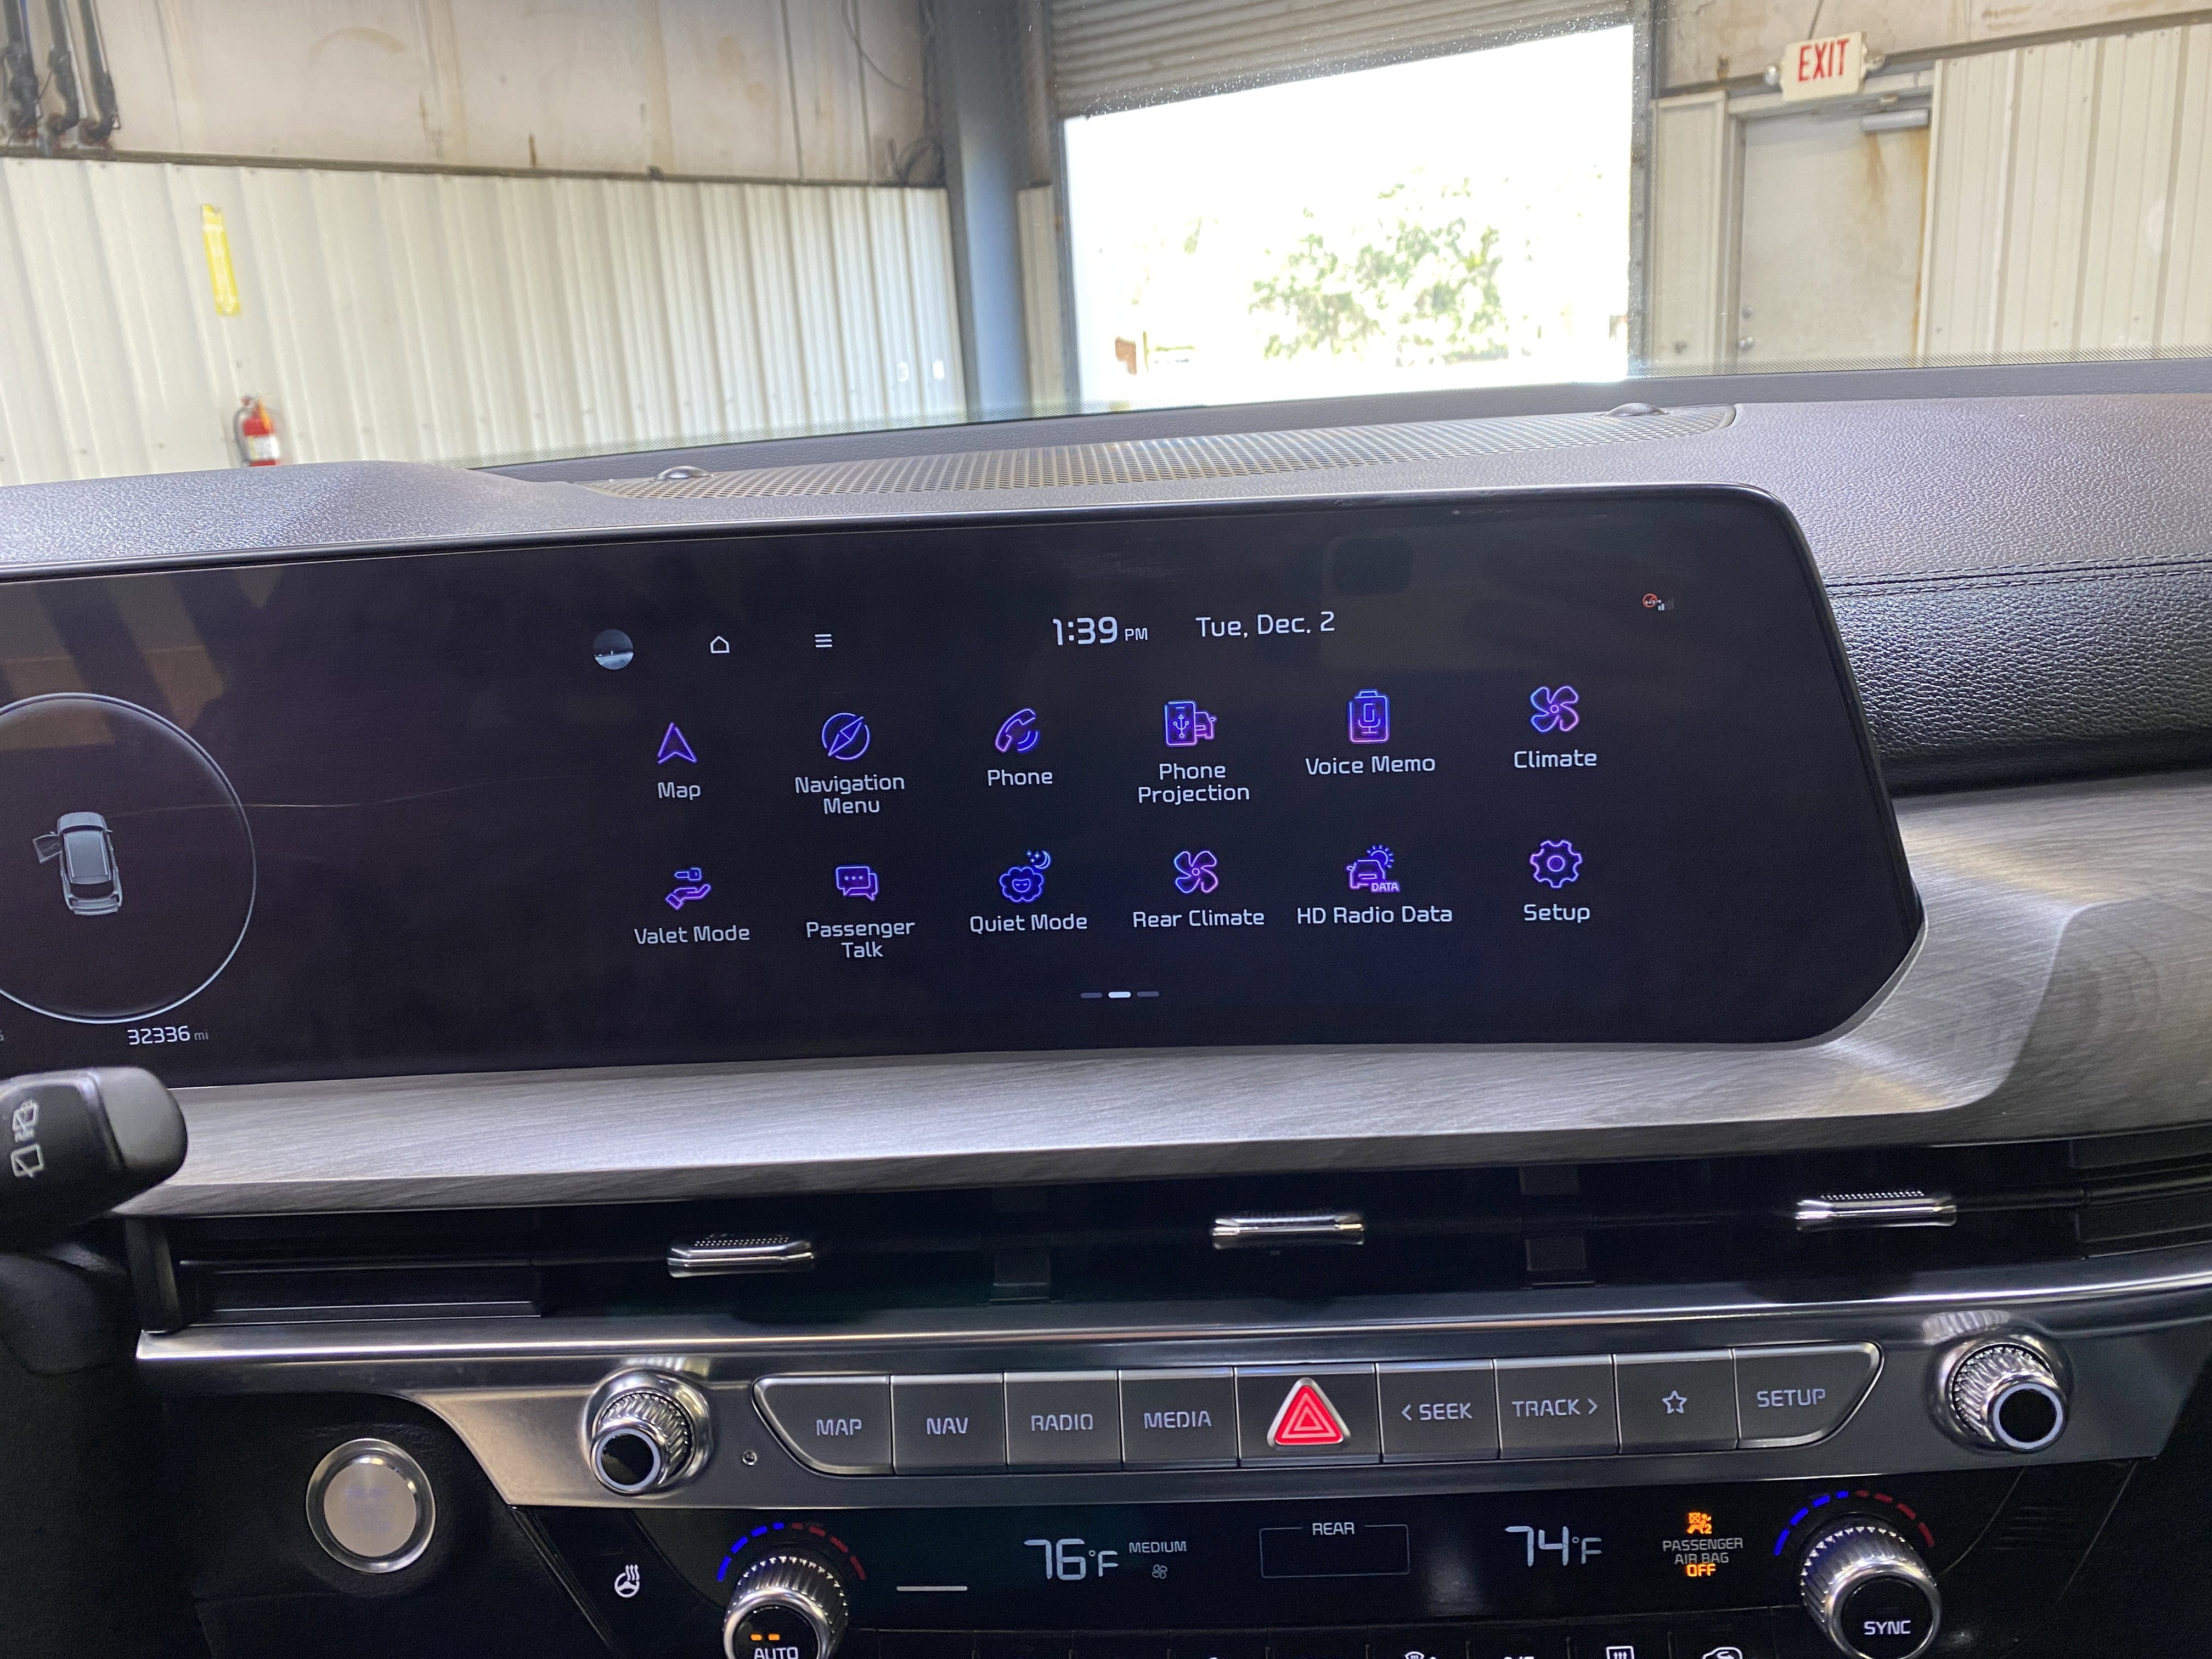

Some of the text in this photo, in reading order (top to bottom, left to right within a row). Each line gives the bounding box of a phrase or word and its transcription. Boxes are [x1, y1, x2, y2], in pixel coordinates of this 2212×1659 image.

[1798, 38, 1850, 81] EXIT
[1052, 616, 1148, 646] 1:39 PM
[1195, 611, 1335, 638] Tue, Dec. 2
[1305, 755, 1435, 775] Voice Memo
[1514, 749, 1597, 769] Climate
[988, 769, 1053, 786] Phone
[1159, 763, 1226, 780] Phone
[658, 782, 701, 800] Map
[795, 774, 905, 795] Navigation
[1138, 784, 1250, 805] Projection
[823, 798, 880, 814] Menu
[1372, 882, 1400, 891] DATA
[1133, 909, 1265, 928] Rear Climate
[1297, 905, 1453, 924] HD Radio Data
[1523, 904, 1590, 923] Setup
[806, 922, 916, 938] Passenger
[970, 913, 1087, 934] Quiet Mode
[634, 924, 750, 944] Valet Mode
[840, 941, 883, 958] Talk
[127, 1025, 208, 1045] 32336 mi
[1757, 1389, 1826, 1408] SETUP
[1419, 1402, 1472, 1420] SEEK
[1511, 1399, 1581, 1417] TRACK
[816, 1418, 862, 1436] MAP
[927, 1417, 968, 1435] NAV
[1031, 1413, 1093, 1431] RADIO
[1143, 1410, 1212, 1429] MEDIA
[1312, 1522, 1355, 1536] REAR
[1129, 1541, 1187, 1554] MEDIUM
[1663, 1538, 1743, 1552] PASSENGER
[1675, 1552, 1729, 1565] AIR BAG
[1686, 1564, 1716, 1577] OFF
[1864, 1620, 1911, 1635] SYNC
[754, 1647, 799, 1659] AUTO
